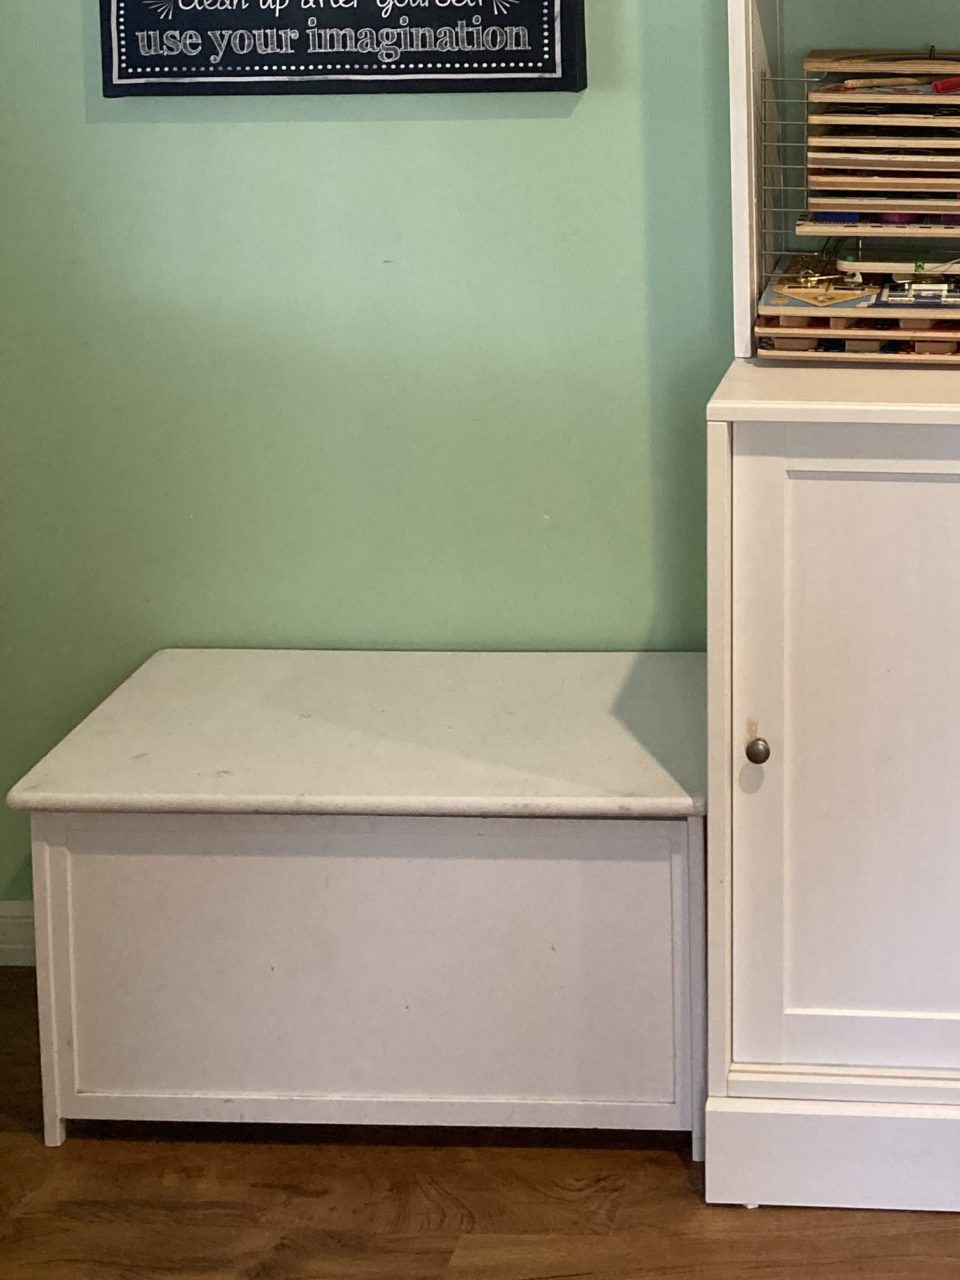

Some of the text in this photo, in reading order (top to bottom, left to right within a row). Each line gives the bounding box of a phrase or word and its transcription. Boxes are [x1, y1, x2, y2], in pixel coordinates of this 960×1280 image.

[135, 15, 531, 63] use your imagination
